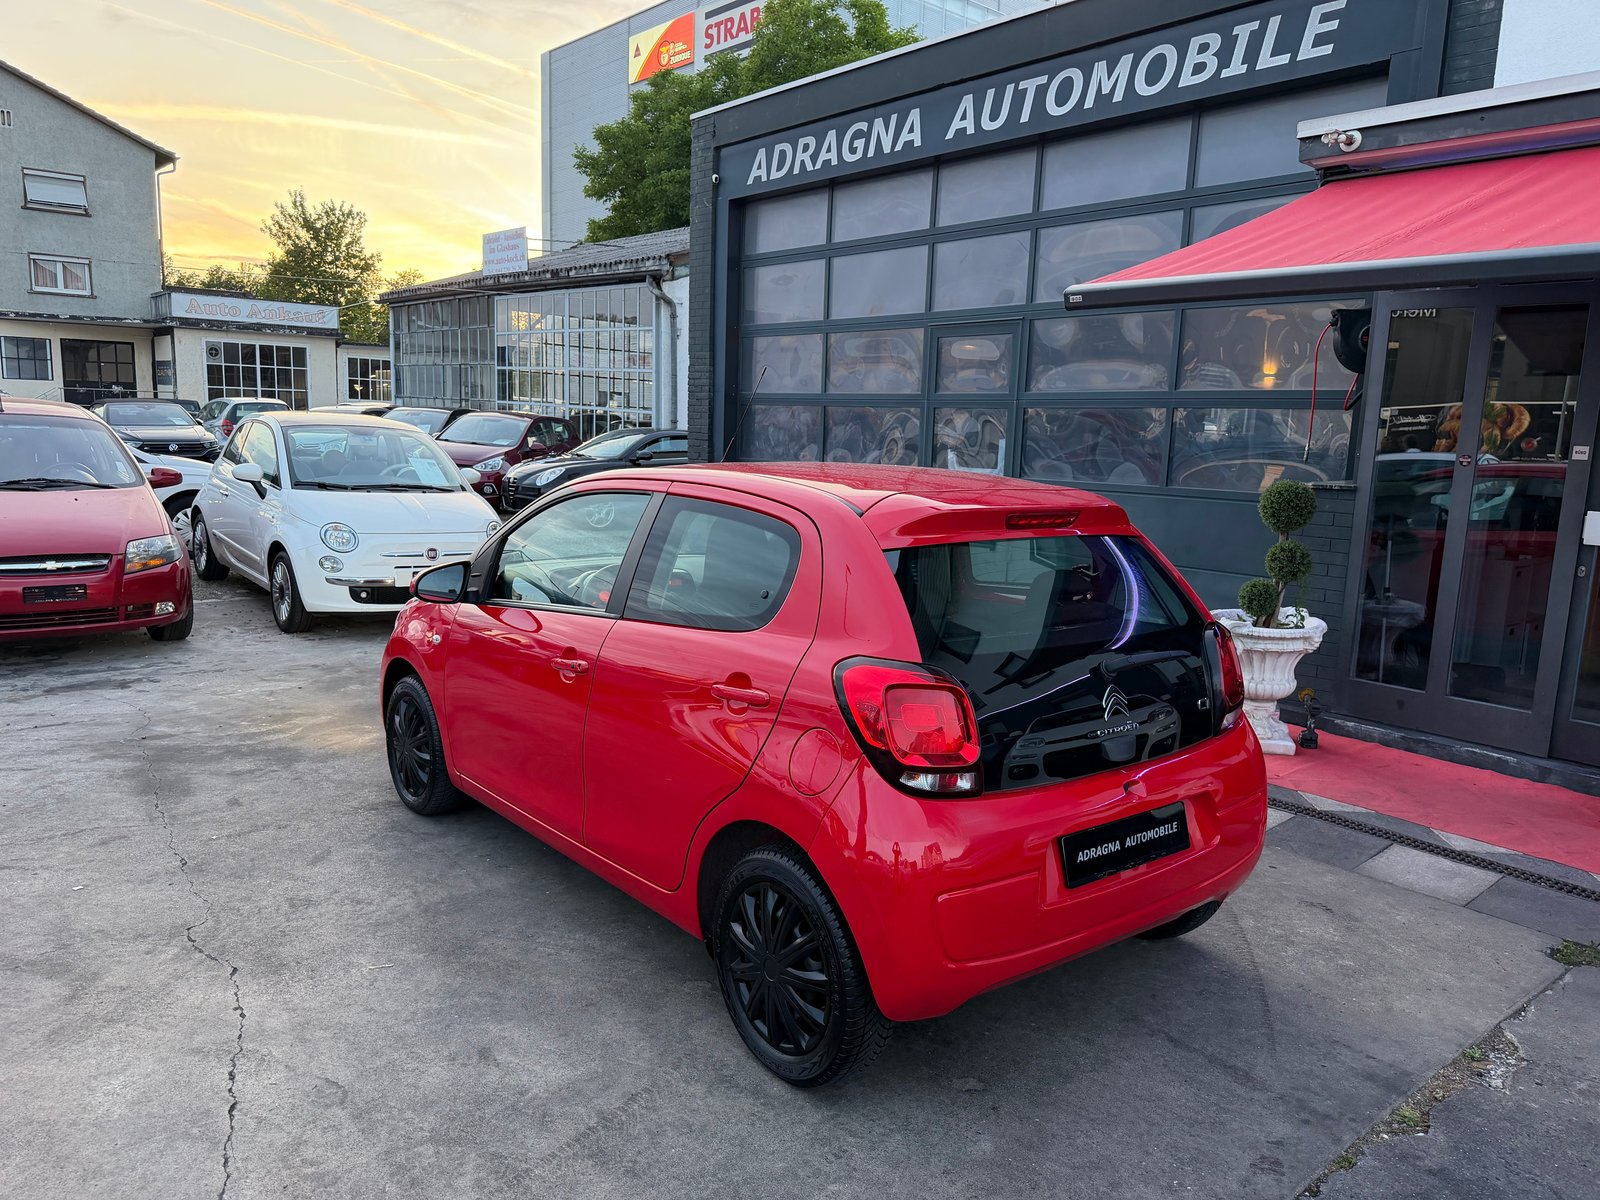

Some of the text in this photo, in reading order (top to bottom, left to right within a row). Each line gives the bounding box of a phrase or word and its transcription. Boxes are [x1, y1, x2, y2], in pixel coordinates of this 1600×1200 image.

[746, 0, 1347, 185] ADRAGNA AUTOMOBILE
[185, 298, 326, 324] Auto Ankauf
[1077, 821, 1178, 863] ADRAGNA AUTOMOBILE
